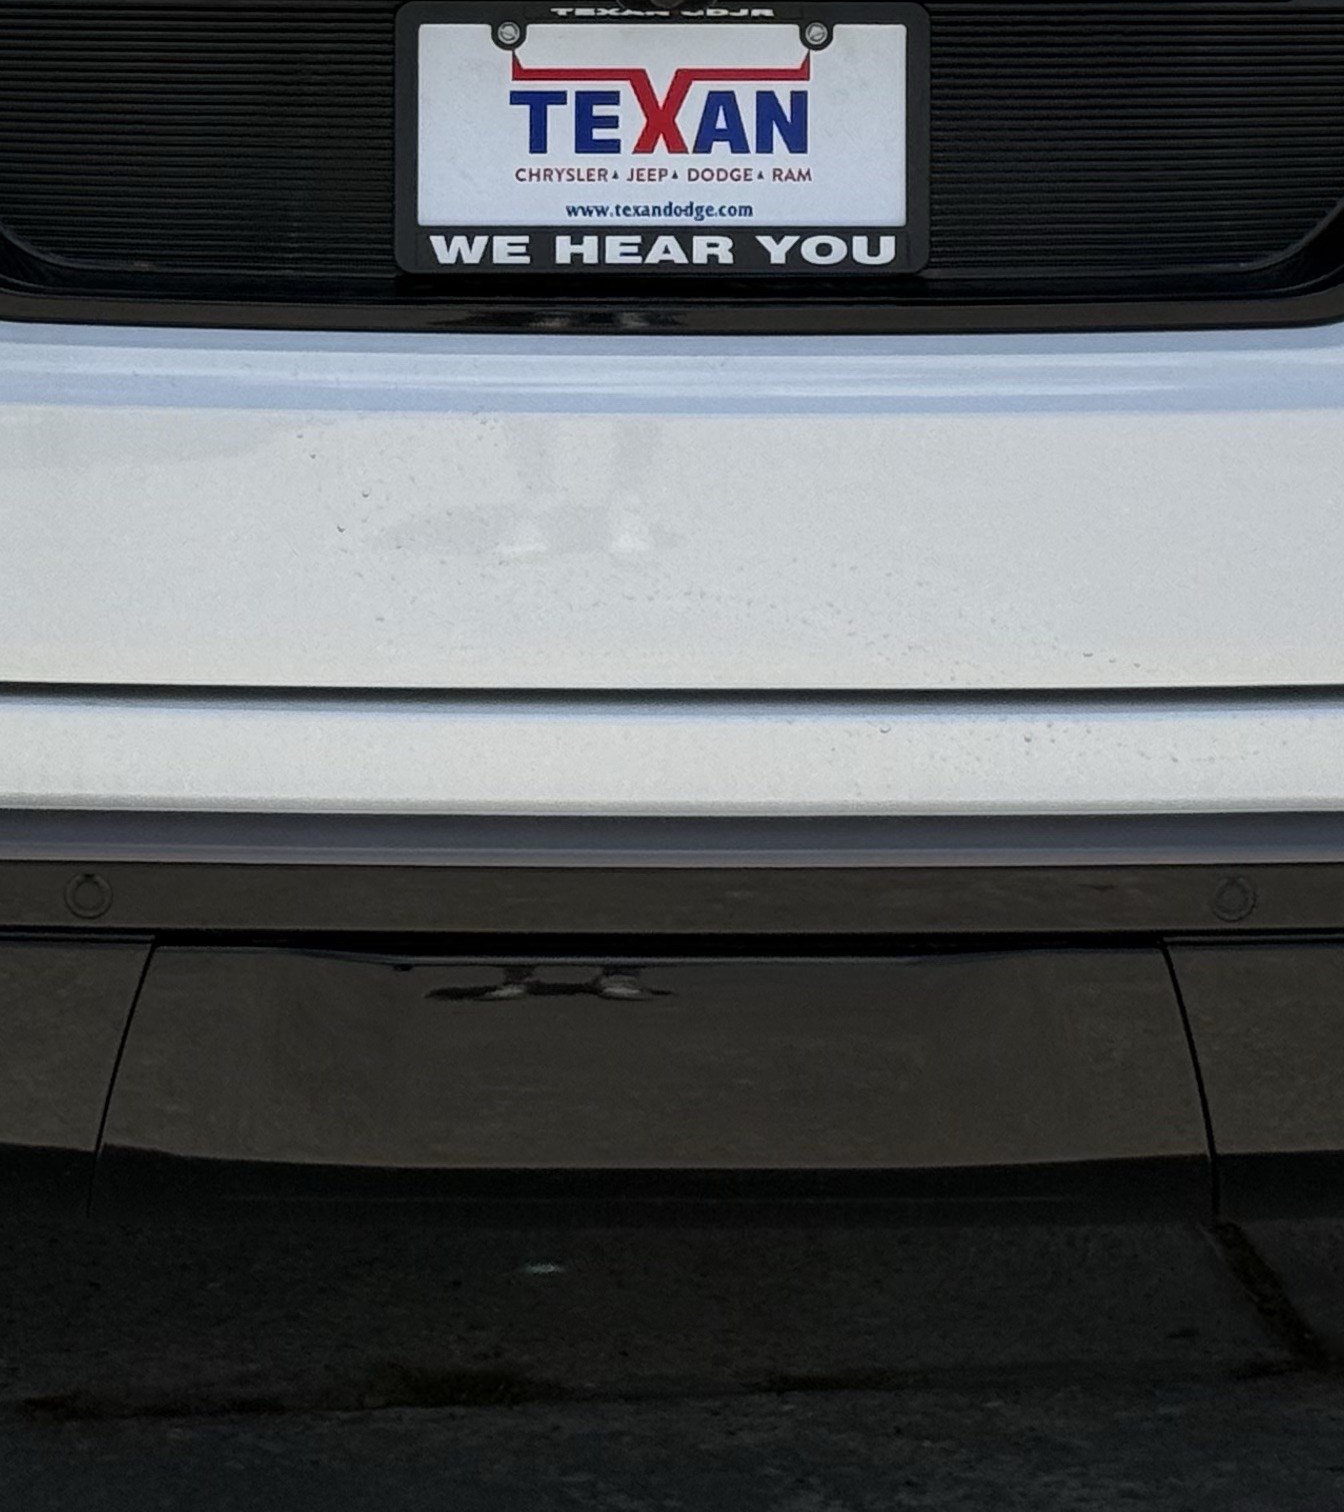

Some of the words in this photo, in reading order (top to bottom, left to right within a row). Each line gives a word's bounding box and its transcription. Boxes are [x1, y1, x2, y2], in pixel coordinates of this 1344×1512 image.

[510, 69, 808, 154] TEXAN
[514, 167, 609, 183] CHRYSLER
[626, 167, 669, 183] JEEP
[687, 167, 754, 183] DODGE
[772, 167, 813, 183] RAM
[565, 201, 754, 221] www.texandodge.com
[429, 235, 531, 265] WE
[556, 235, 734, 265] HEAR
[755, 235, 896, 265] YOU
